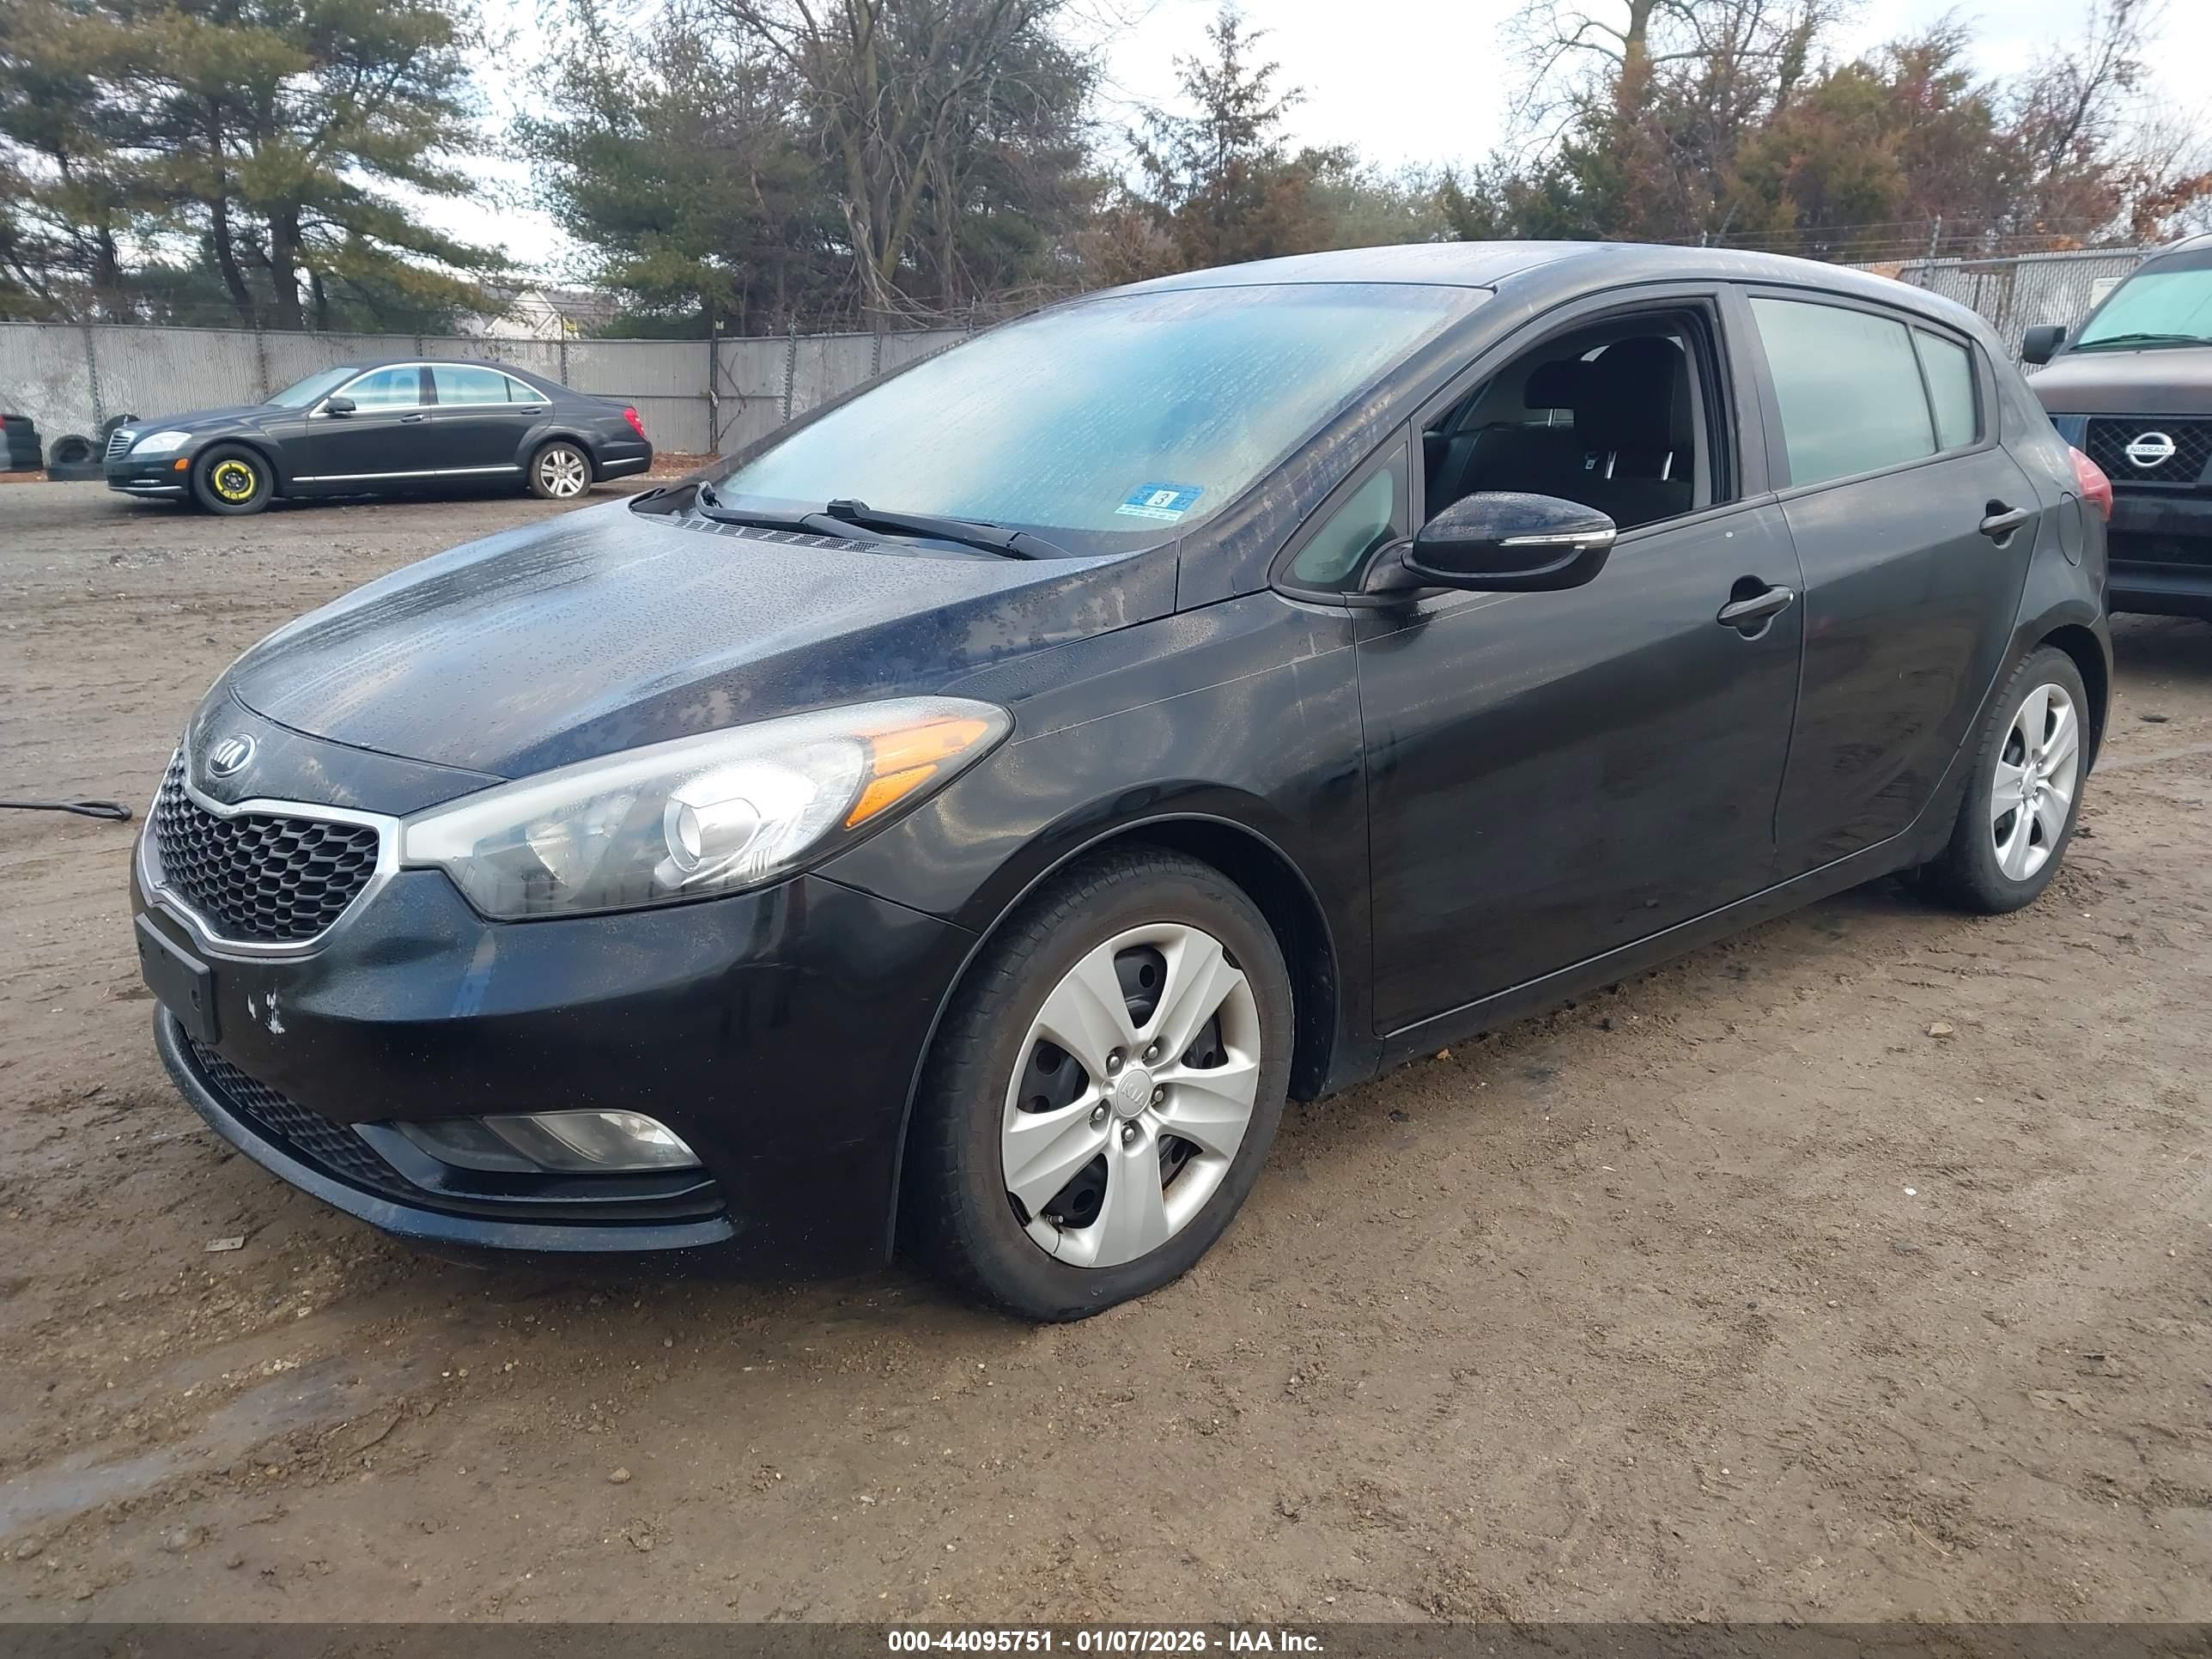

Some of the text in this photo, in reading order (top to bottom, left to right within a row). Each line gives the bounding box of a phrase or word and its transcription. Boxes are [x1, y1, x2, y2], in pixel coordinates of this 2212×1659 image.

[1154, 493, 1170, 505] 3
[212, 738, 246, 769] KIA
[1121, 1082, 1145, 1107] KIA
